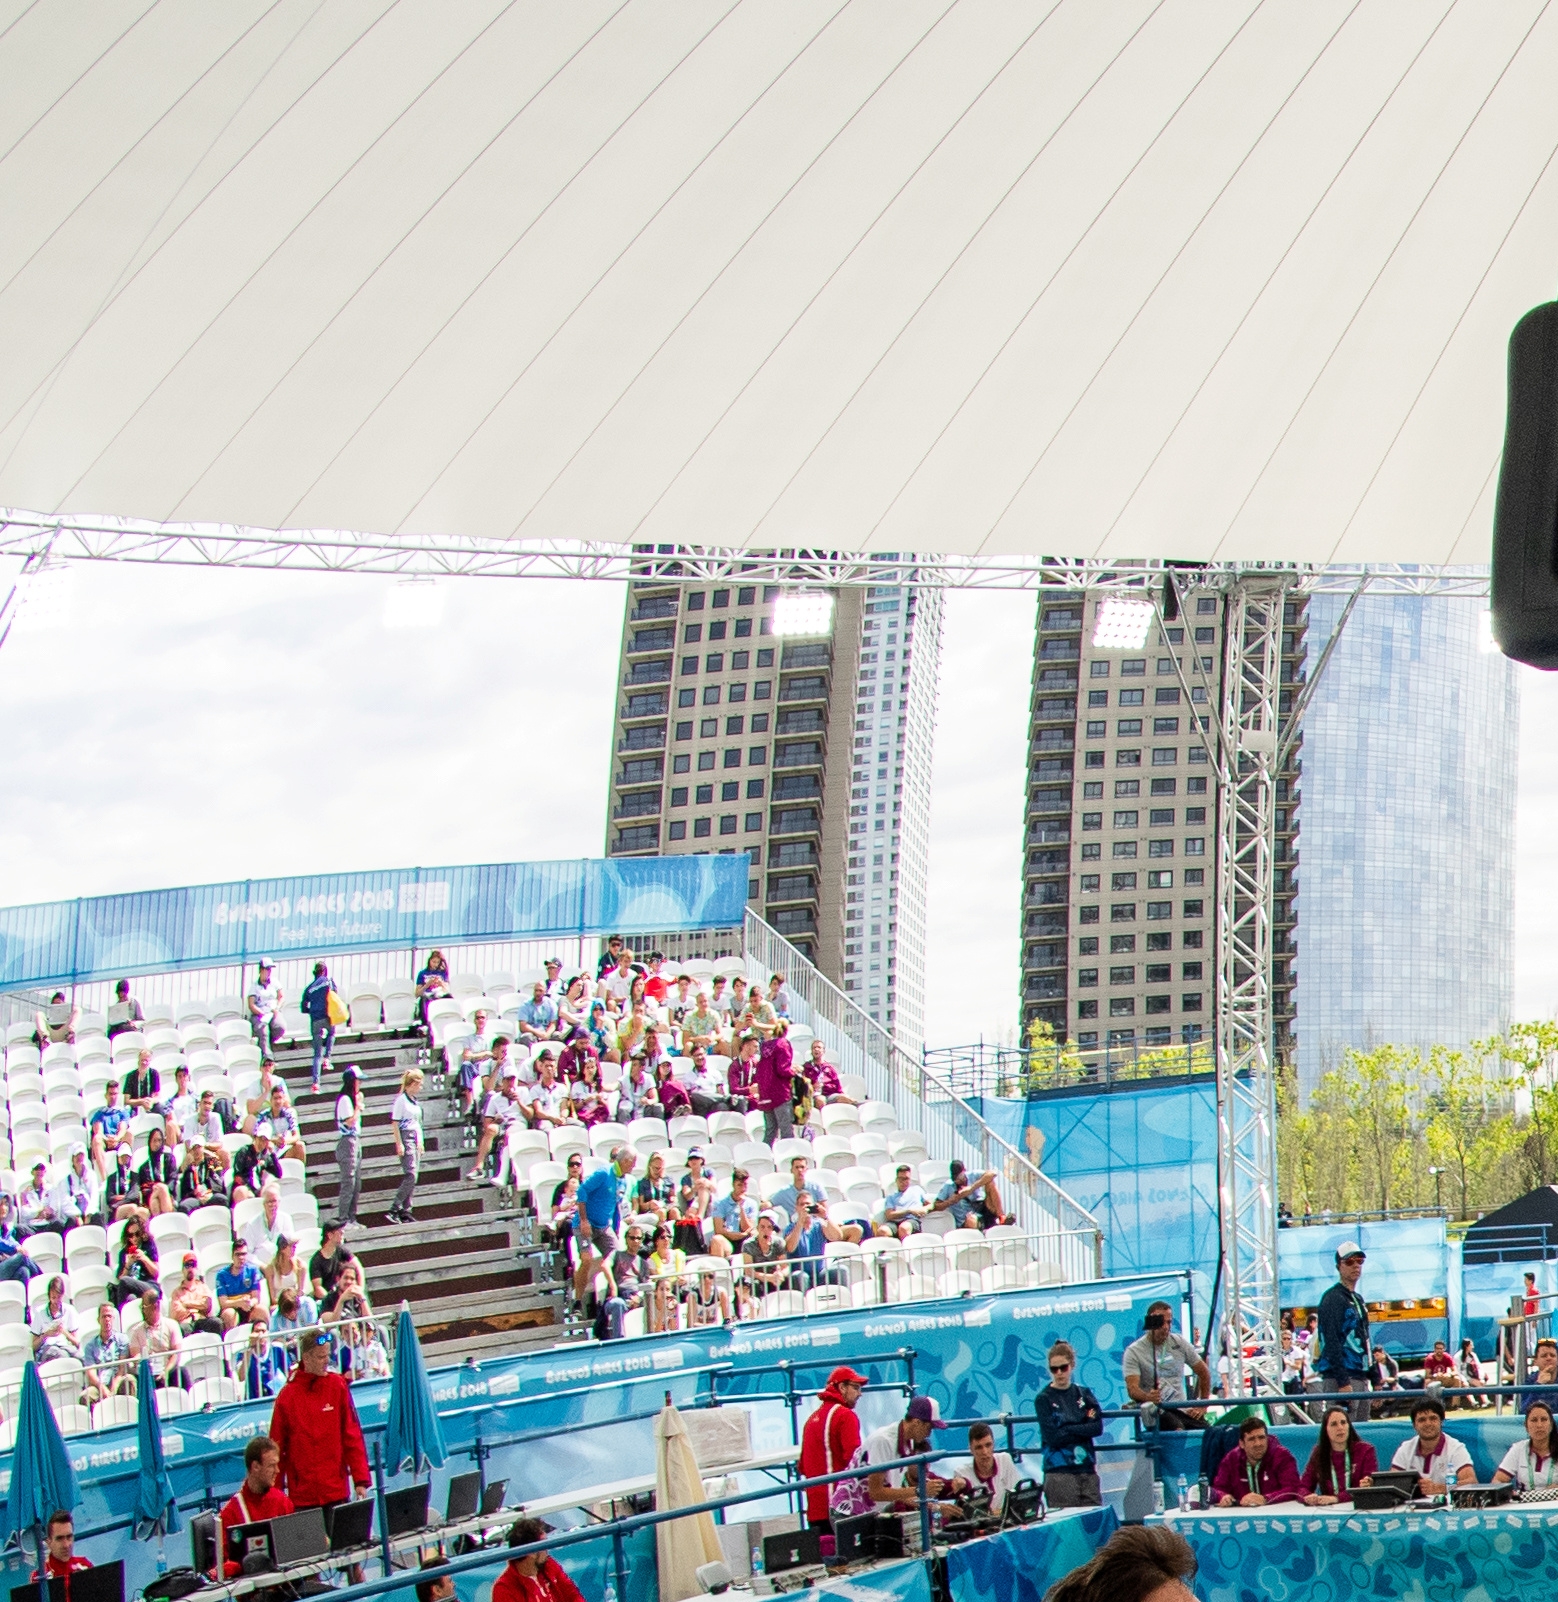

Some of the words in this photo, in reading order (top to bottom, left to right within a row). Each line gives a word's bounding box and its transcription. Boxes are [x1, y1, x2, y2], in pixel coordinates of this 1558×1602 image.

[215, 899, 291, 926] BUENOS
[294, 892, 347, 916] AIRES
[350, 888, 395, 913] 2018
[280, 925, 310, 942] Feel
[313, 922, 338, 939] the
[340, 919, 382, 937] future
